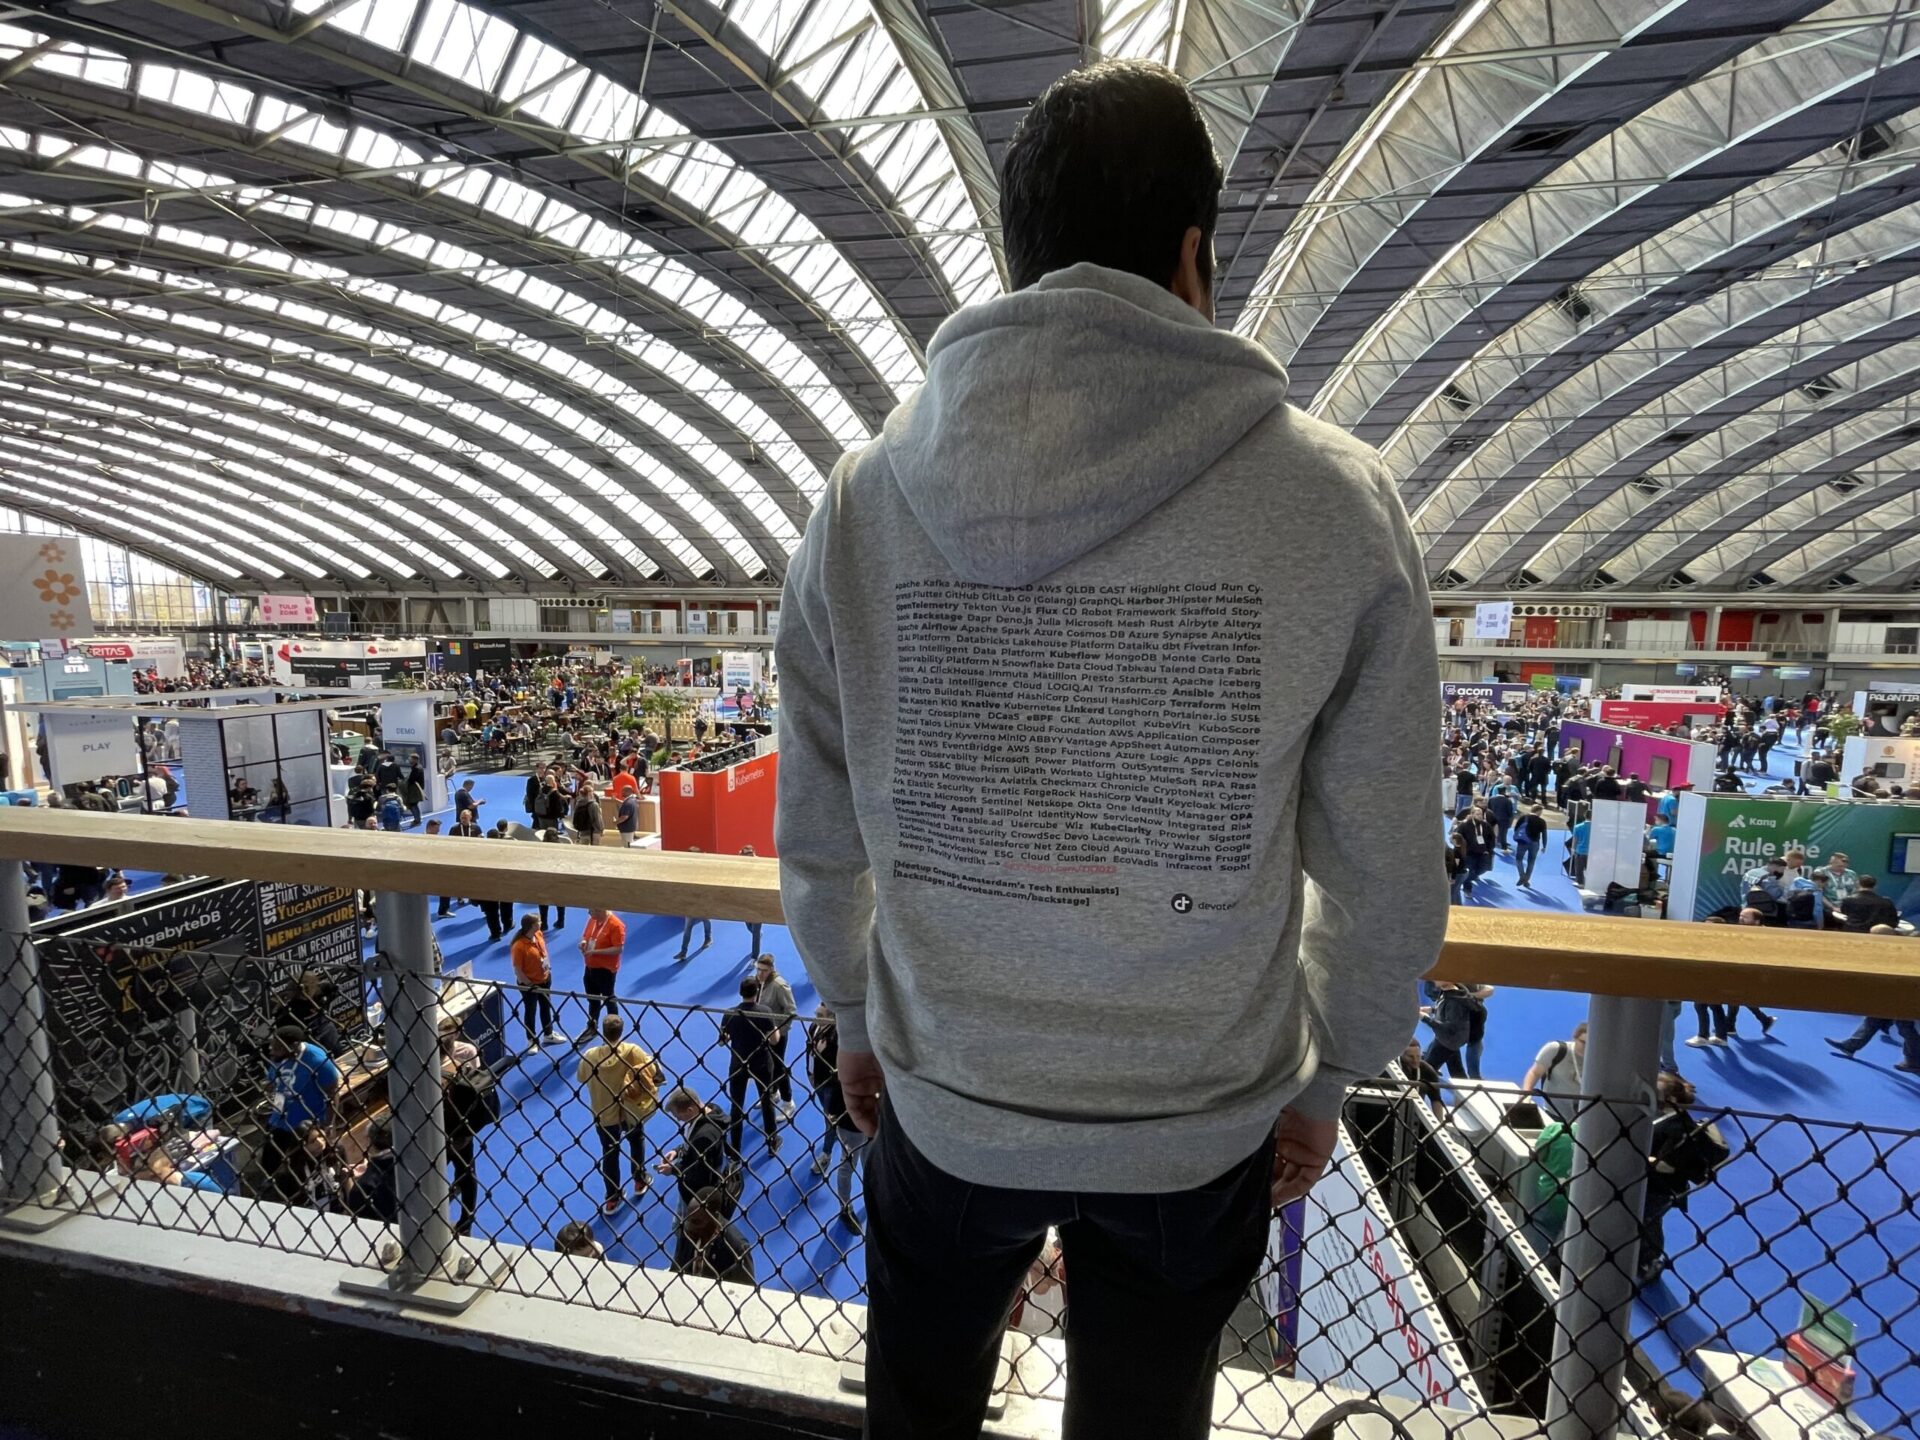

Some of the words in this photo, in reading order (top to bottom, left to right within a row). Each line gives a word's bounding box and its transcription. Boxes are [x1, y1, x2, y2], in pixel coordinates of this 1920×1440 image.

[945, 592, 979, 600] GitHub
[982, 593, 1014, 601] GitLab
[1080, 598, 1124, 606] GraphQL
[1130, 584, 1180, 596] Highlight
[963, 603, 997, 611] Tekton
[913, 613, 962, 622] Backstage
[1179, 620, 1218, 628] Airbyte
[922, 623, 957, 631] Airflow
[961, 626, 998, 635] Apache
[1002, 627, 1030, 636] Spark
[1163, 632, 1208, 641] Synapse
[1212, 632, 1261, 641] Analytics
[957, 635, 1009, 645] Databricks
[1013, 638, 1067, 648] Lakehouse
[1071, 641, 1114, 649] Platform
[1184, 642, 1229, 651] Fivetran
[919, 645, 968, 654] Intelligent
[1001, 648, 1045, 657] Platform
[1106, 653, 1156, 663] MongoDB
[1202, 655, 1230, 663] Carlo
[1237, 655, 1261, 664] Data
[946, 656, 989, 665] Platform
[1002, 660, 1054, 668] Snowflake
[1084, 662, 1113, 671] Cloud
[1228, 667, 1261, 676] Fabric
[930, 667, 984, 676] ClickHouse
[989, 669, 1028, 678] Immuta
[1119, 675, 1167, 684] Starburst
[1173, 677, 1213, 686] Apache
[949, 678, 1007, 688] Intelligence
[1013, 681, 1042, 689] Cloud
[1173, 689, 1214, 698] Ansible
[1221, 691, 1261, 699] Anthos
[1458, 688, 1493, 696] acorn
[935, 687, 971, 696] Buildah
[1018, 692, 1068, 702] HashiCorp
[1073, 695, 1107, 704] Consul
[1112, 697, 1166, 707] HashiCorp
[1170, 700, 1225, 709] Terraform
[961, 700, 1000, 709] Knative
[1004, 702, 1061, 711] Kubernetes
[1108, 708, 1159, 717] Longhorn
[1088, 718, 1136, 727] Autopilot
[974, 722, 1013, 731] VMware
[1049, 725, 1106, 736] Foundation
[1202, 735, 1259, 745] Composer
[82, 742, 111, 752] PLAY
[942, 742, 1002, 752] EventBridge
[1034, 746, 1056, 755] Step
[1062, 747, 1110, 758] Functions
[1115, 751, 1145, 760] Azure
[1150, 754, 1178, 763] Logic
[1184, 756, 1211, 765] Apps
[1066, 738, 1107, 747] Vantage
[1164, 744, 1229, 756] Automation
[984, 754, 1029, 763] Microsoft
[1035, 757, 1066, 765] Power
[1072, 759, 1115, 769] Platform
[1191, 767, 1257, 778] ServiceNow
[736, 768, 765, 786] Kubernetes
[942, 773, 996, 783] Moveworks
[1101, 782, 1149, 792] Chronicle
[981, 765, 1009, 774] Prism
[1098, 771, 1145, 782] Lightstep
[1150, 776, 1197, 786] MuleSoft
[937, 783, 974, 794] Security
[1024, 788, 1075, 798] ForgeRock
[1135, 795, 1163, 804] Vault
[935, 793, 977, 803] Microsoft
[981, 797, 1022, 806] Sentinel
[1027, 799, 1073, 809] Netskope
[1176, 810, 1225, 821] Manager
[1230, 812, 1252, 821] OPA
[1011, 820, 1057, 829] Usercube
[1091, 823, 1151, 835] KubeClarity
[1103, 813, 1163, 826] ServiceNow
[968, 826, 1007, 838] Security
[1011, 831, 1060, 840] CrowdSec
[1173, 842, 1210, 852] Wazuh
[979, 838, 1030, 850] Salesforce
[1082, 843, 1110, 852] Cloud
[1725, 836, 1776, 856] Rule
[1782, 838, 1820, 858] the
[1021, 852, 1049, 861] Cloud
[1028, 883, 1052, 893] Tech
[266, 926, 302, 951] MENU
[311, 904, 355, 929] FUTURE
